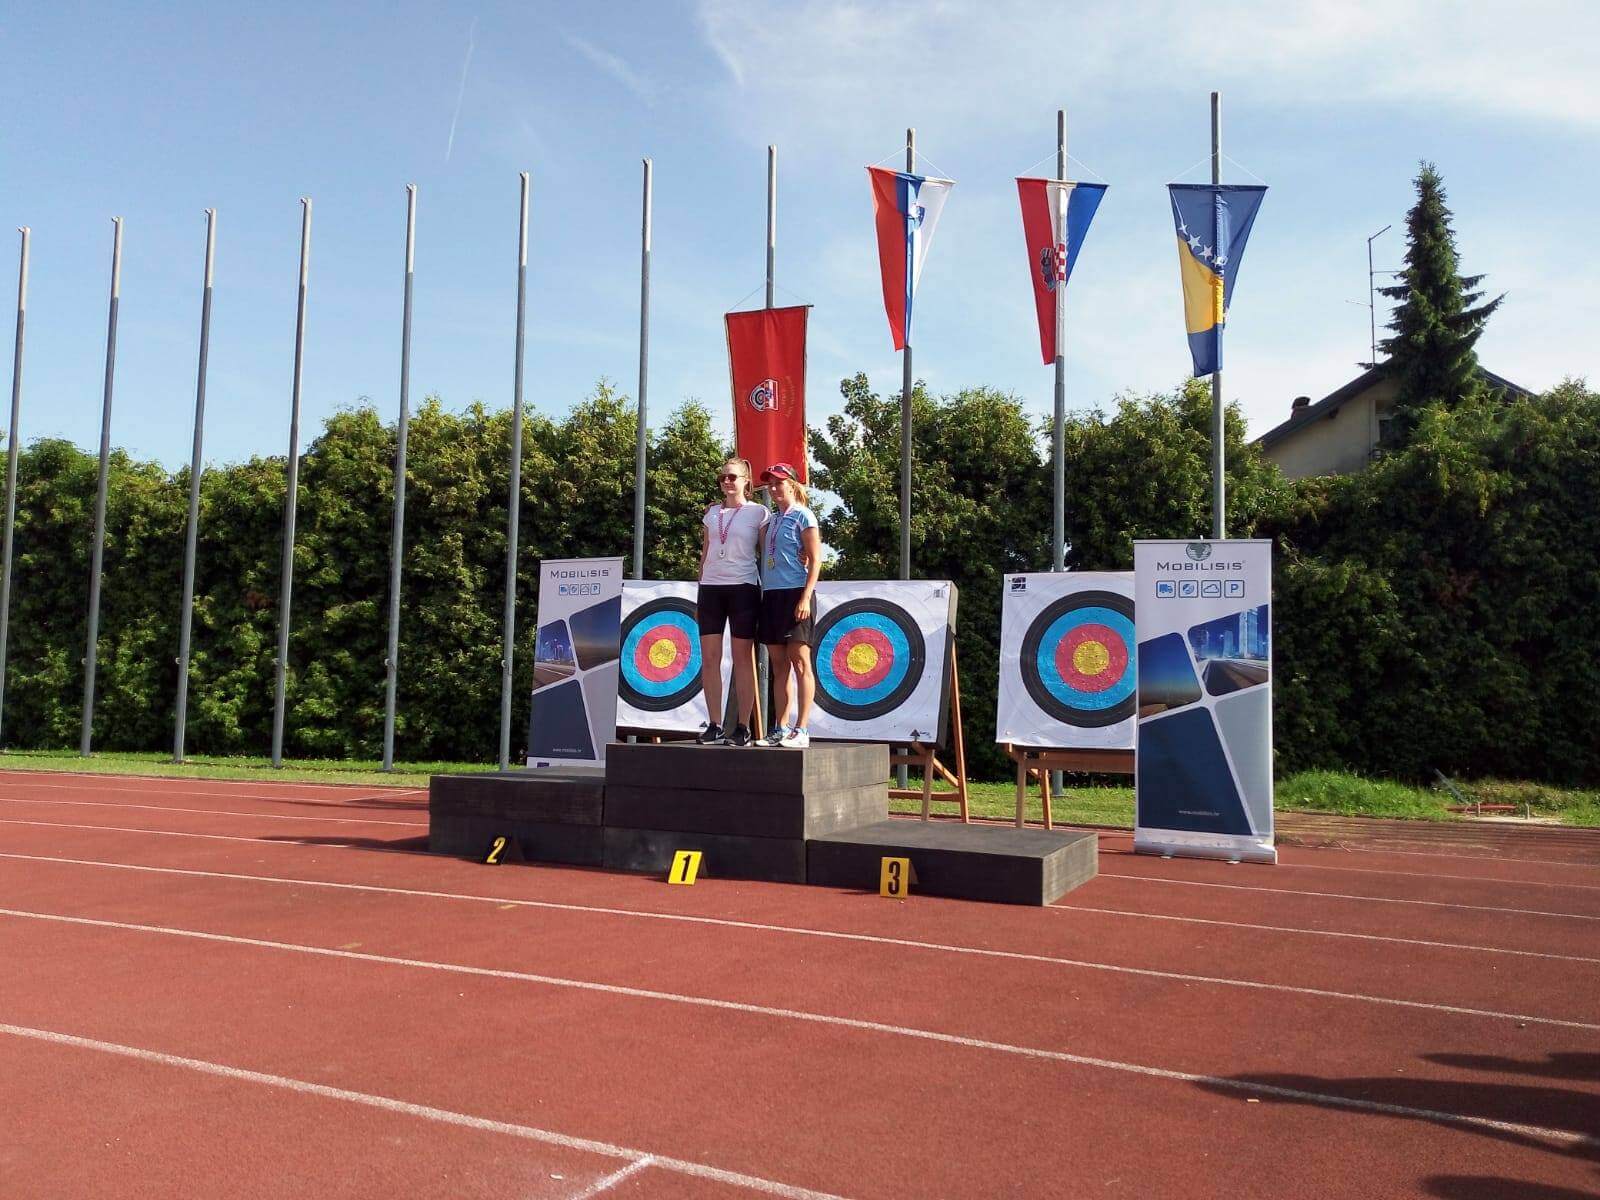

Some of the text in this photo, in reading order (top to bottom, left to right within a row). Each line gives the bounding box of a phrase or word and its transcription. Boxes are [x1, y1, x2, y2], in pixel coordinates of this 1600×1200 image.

[1157, 562, 1243, 571] MOBILISIS
[1230, 584, 1239, 593] P
[486, 837, 506, 864] 2
[680, 854, 692, 882] 1
[887, 861, 901, 895] 3
